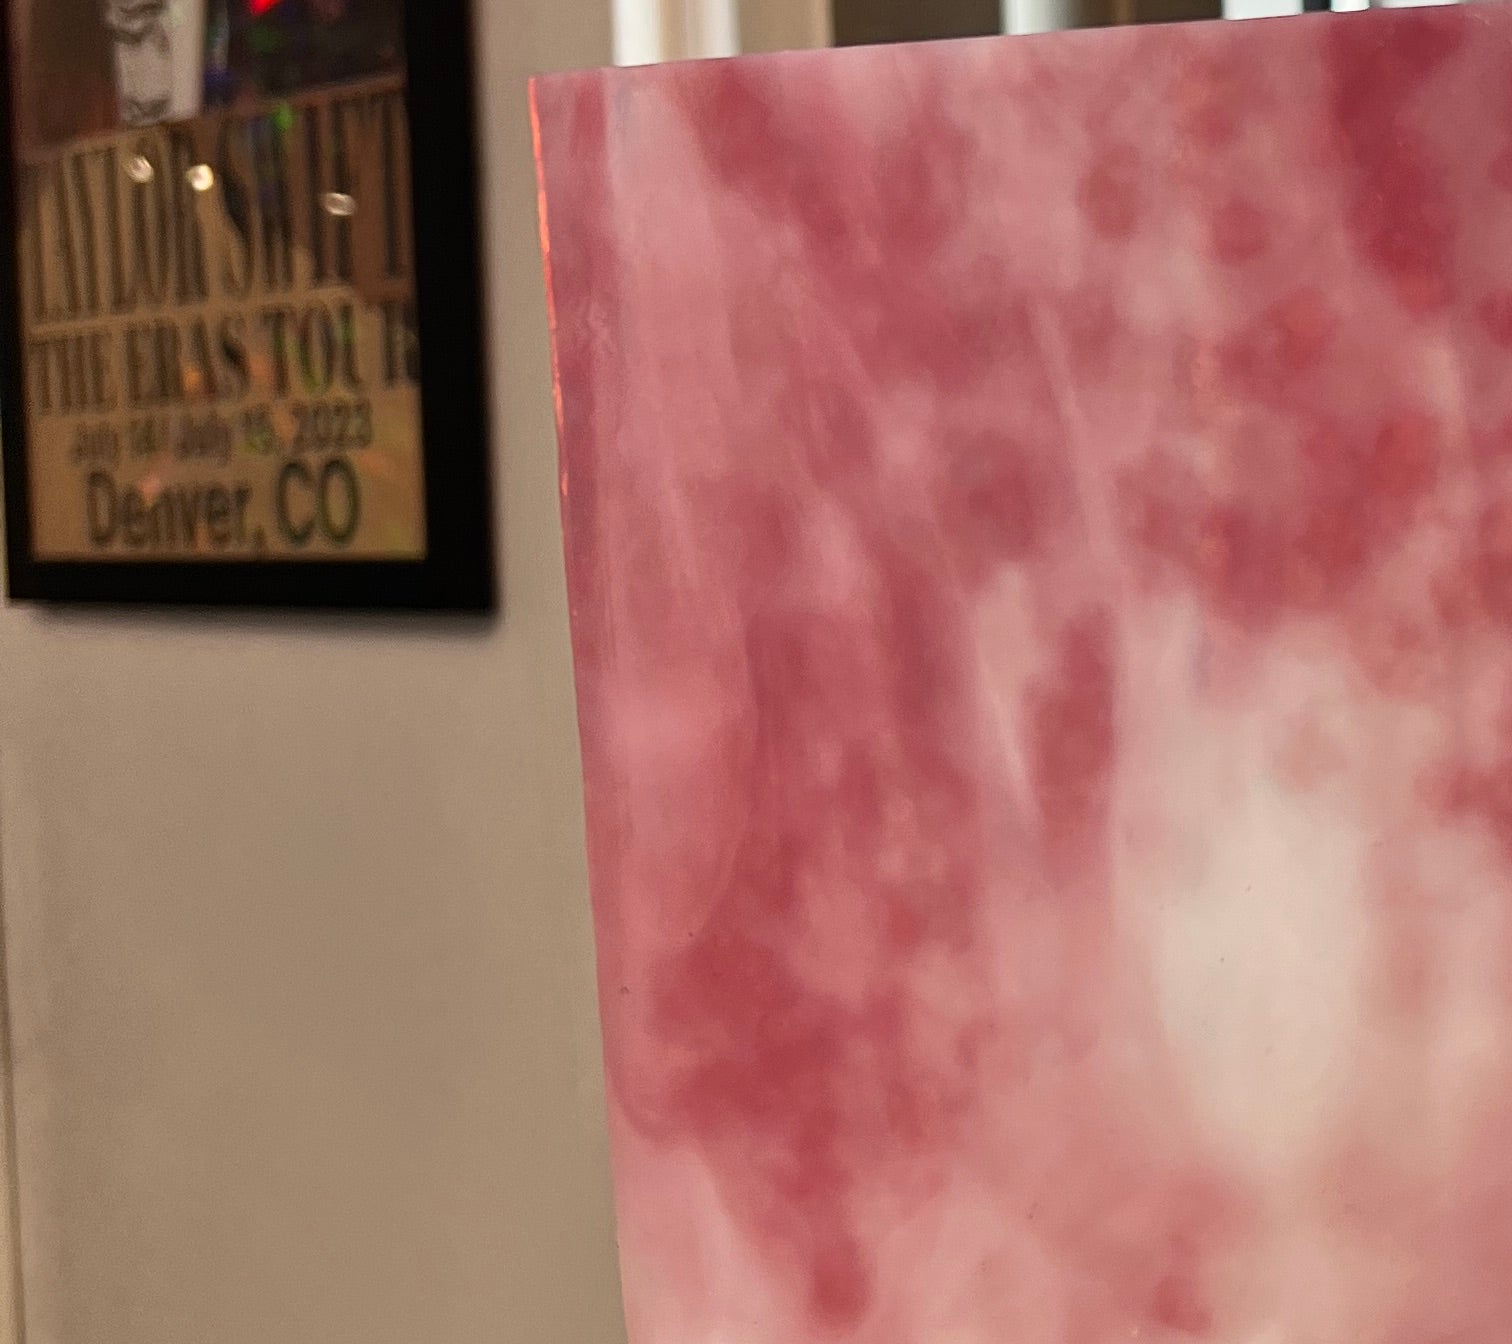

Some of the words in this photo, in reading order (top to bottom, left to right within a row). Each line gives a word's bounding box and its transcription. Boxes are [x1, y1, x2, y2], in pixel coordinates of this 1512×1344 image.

[122, 311, 250, 408] ERAS
[292, 395, 374, 455] 2023
[277, 459, 361, 546] CO
